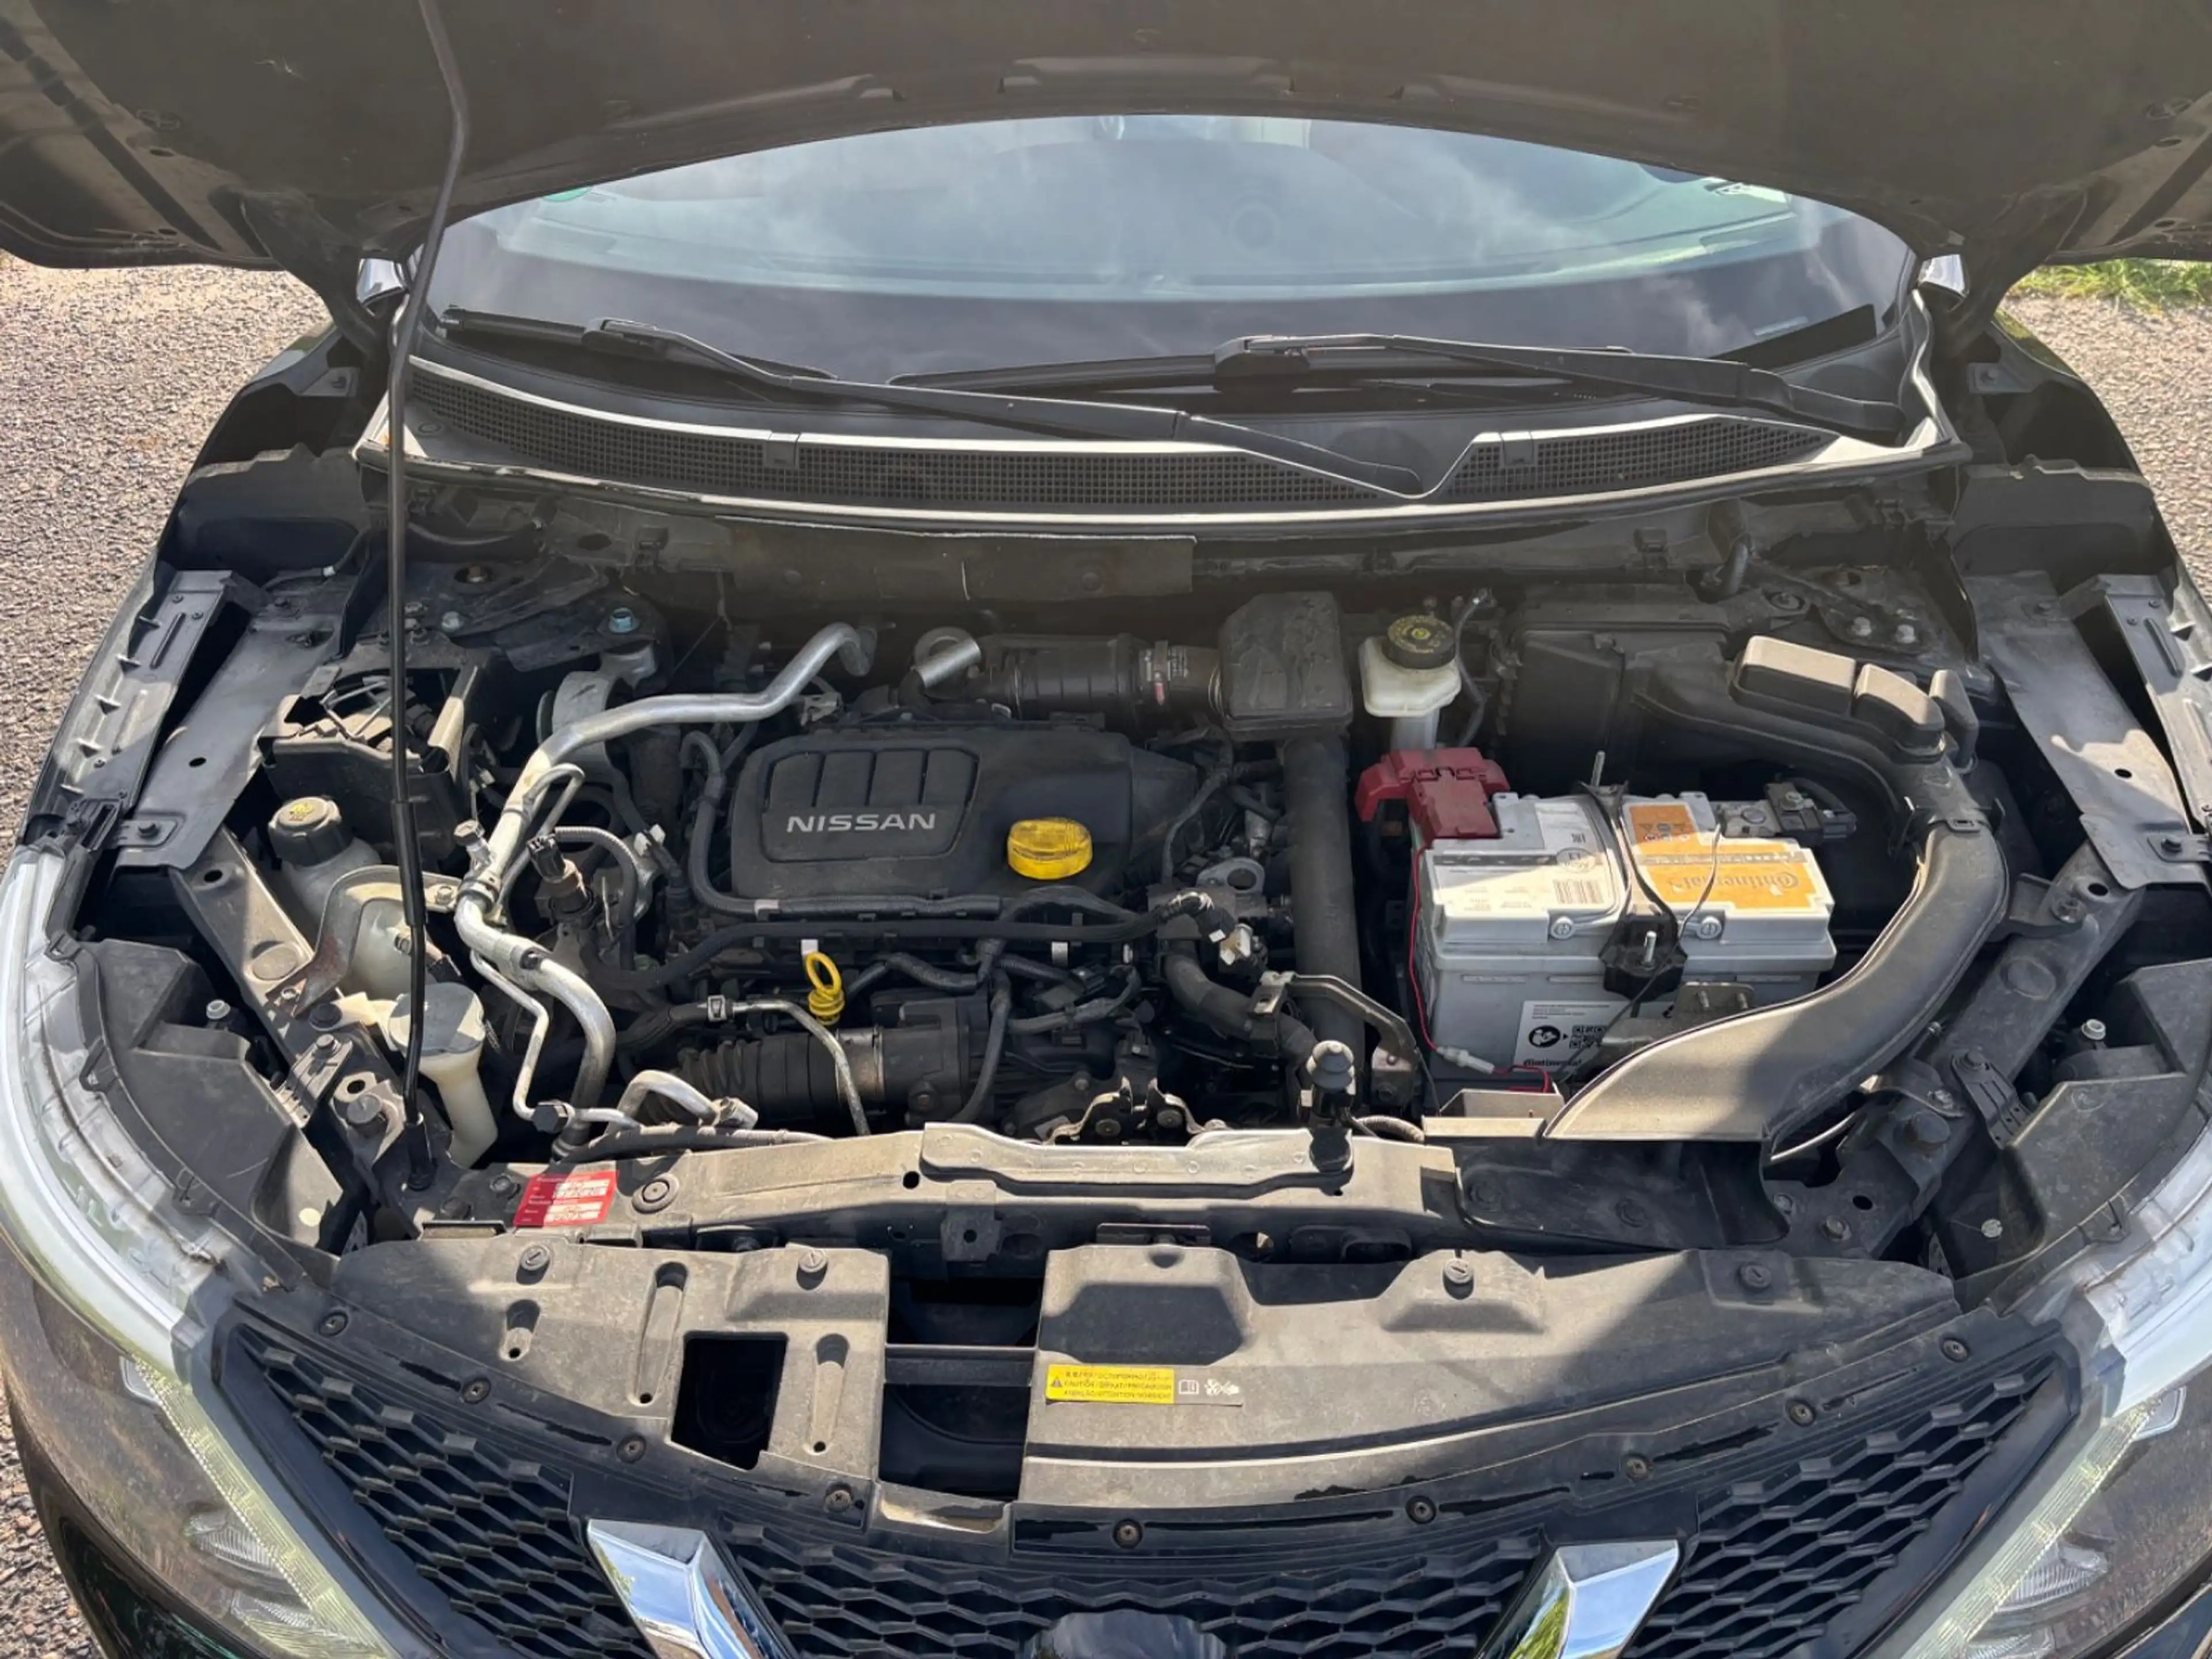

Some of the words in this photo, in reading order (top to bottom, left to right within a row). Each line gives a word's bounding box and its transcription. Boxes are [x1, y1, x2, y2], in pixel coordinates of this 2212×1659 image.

[787, 813, 935, 833] NISSAN
[1682, 870, 1800, 889] Contineal
[1523, 1058, 1582, 1067] Contineal
